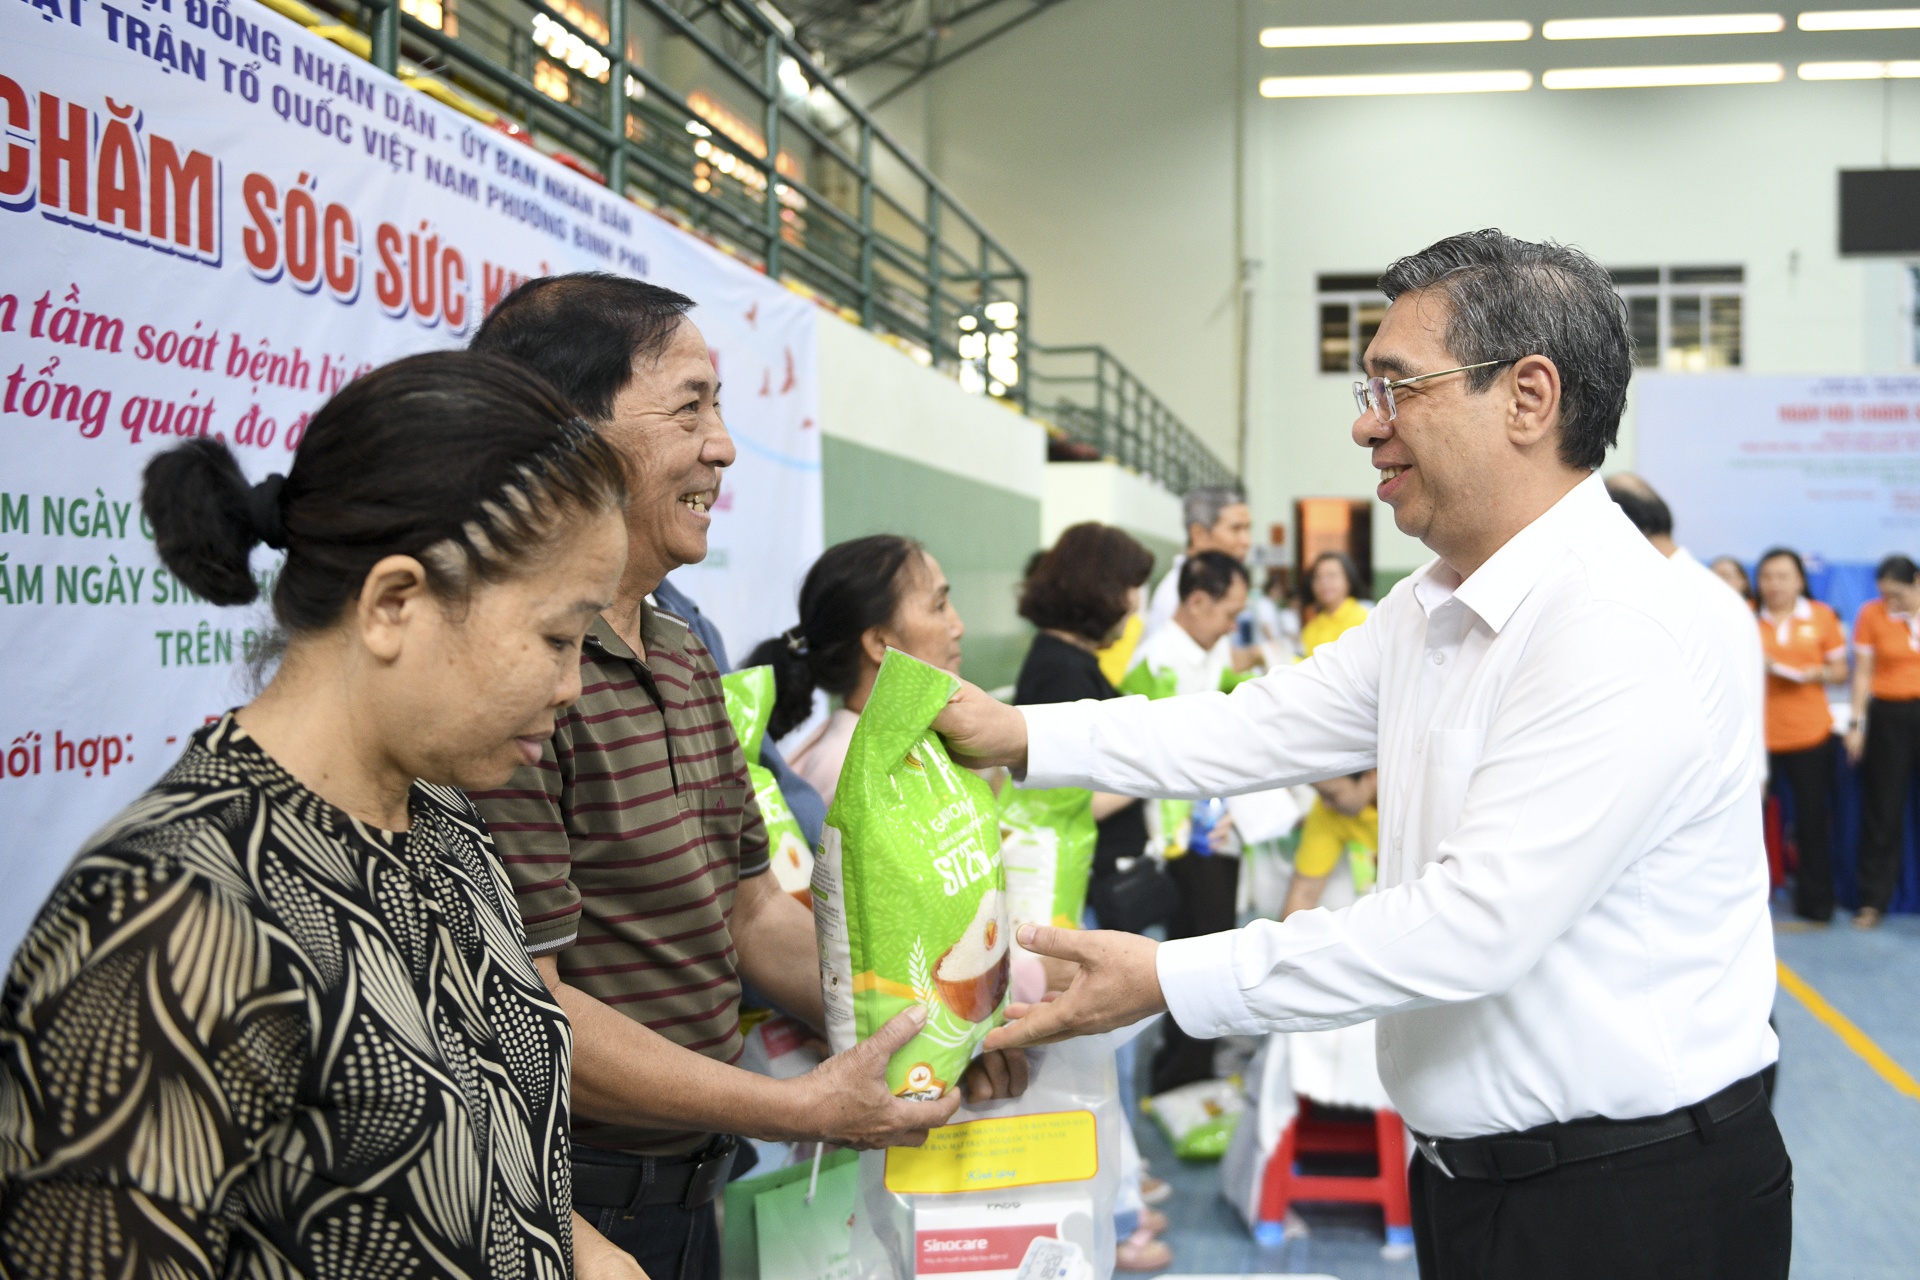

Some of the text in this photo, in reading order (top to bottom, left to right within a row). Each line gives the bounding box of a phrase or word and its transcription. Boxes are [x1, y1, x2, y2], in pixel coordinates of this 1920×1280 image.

[101, 2, 207, 82] TRẬN
[218, 57, 261, 104] TỔ
[272, 84, 353, 145] QUỐC
[362, 124, 418, 175] VIỆT
[425, 155, 479, 202] NAM
[185, 0, 281, 66] ĐỒNG
[293, 46, 374, 111] NHÂN
[385, 91, 436, 141] DÂN
[496, 148, 539, 190] BAN
[0, 73, 216, 258] CHĂM
[242, 170, 358, 298] SÓC
[376, 218, 468, 330] SỨC
[29, 282, 126, 354] tầm
[133, 319, 219, 372] soát
[225, 332, 311, 396] bệnh
[2, 355, 112, 439] tổng
[234, 403, 277, 450] đo
[43, 487, 132, 539] NGÀY
[56, 553, 145, 605] NGÀY
[154, 619, 233, 667] TRÊN
[54, 729, 135, 778] hợp:
[922, 1238, 989, 1252] Sinocare
